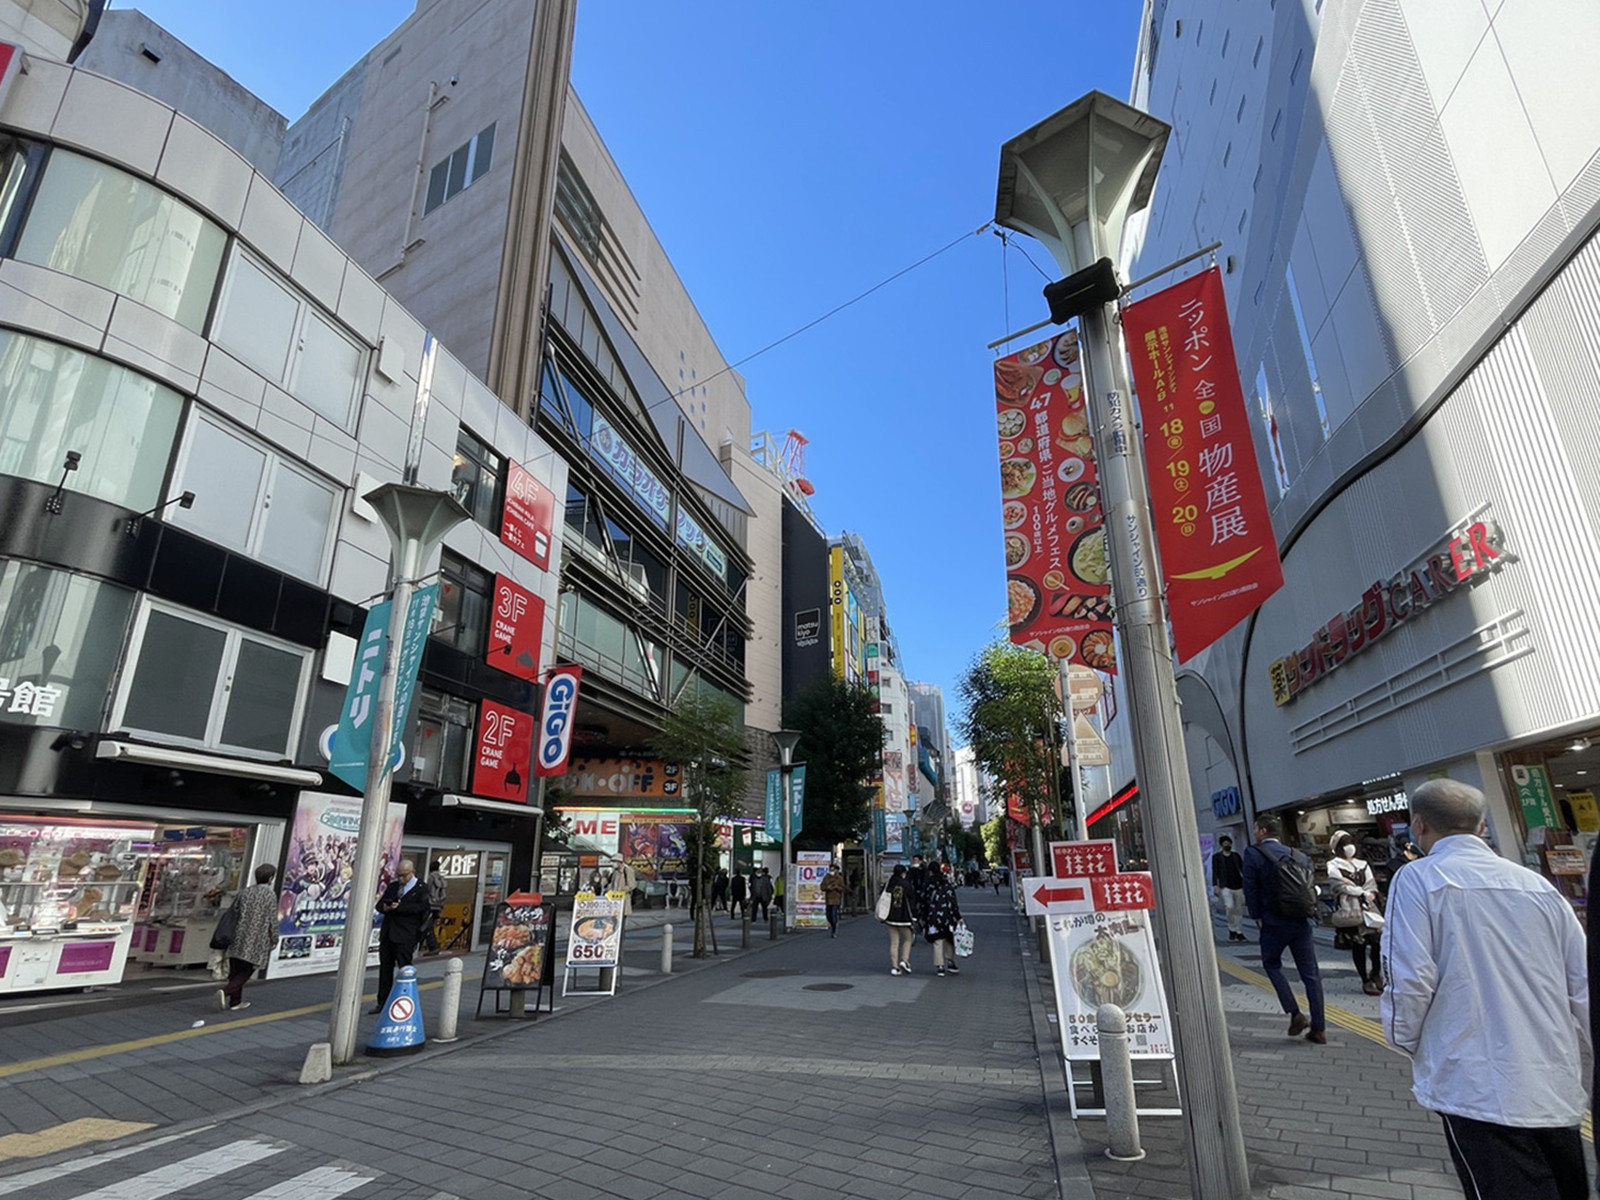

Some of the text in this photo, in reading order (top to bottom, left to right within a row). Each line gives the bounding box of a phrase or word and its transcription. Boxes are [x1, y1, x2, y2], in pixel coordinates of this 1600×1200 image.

[1160, 418, 1184, 437] 18
[1166, 460, 1190, 477] 19
[511, 471, 538, 505] 4F
[1172, 505, 1197, 523] 20
[498, 586, 527, 622] 3F
[494, 630, 512, 644] GAME
[495, 620, 516, 636] CRANE
[1284, 580, 1388, 694] サンドラッグ
[350, 628, 382, 729] ニトリ
[483, 710, 515, 747] 2F
[543, 678, 574, 763] GiGO
[480, 757, 499, 769] GAME
[481, 746, 503, 760] CRANE
[665, 765, 678, 773] 2F
[664, 783, 678, 791] 3F
[793, 778, 802, 816] ニトリ
[575, 820, 617, 834] ME
[450, 854, 478, 875] B1F
[1065, 853, 1106, 874] 桂花
[1103, 881, 1143, 904] 桂花
